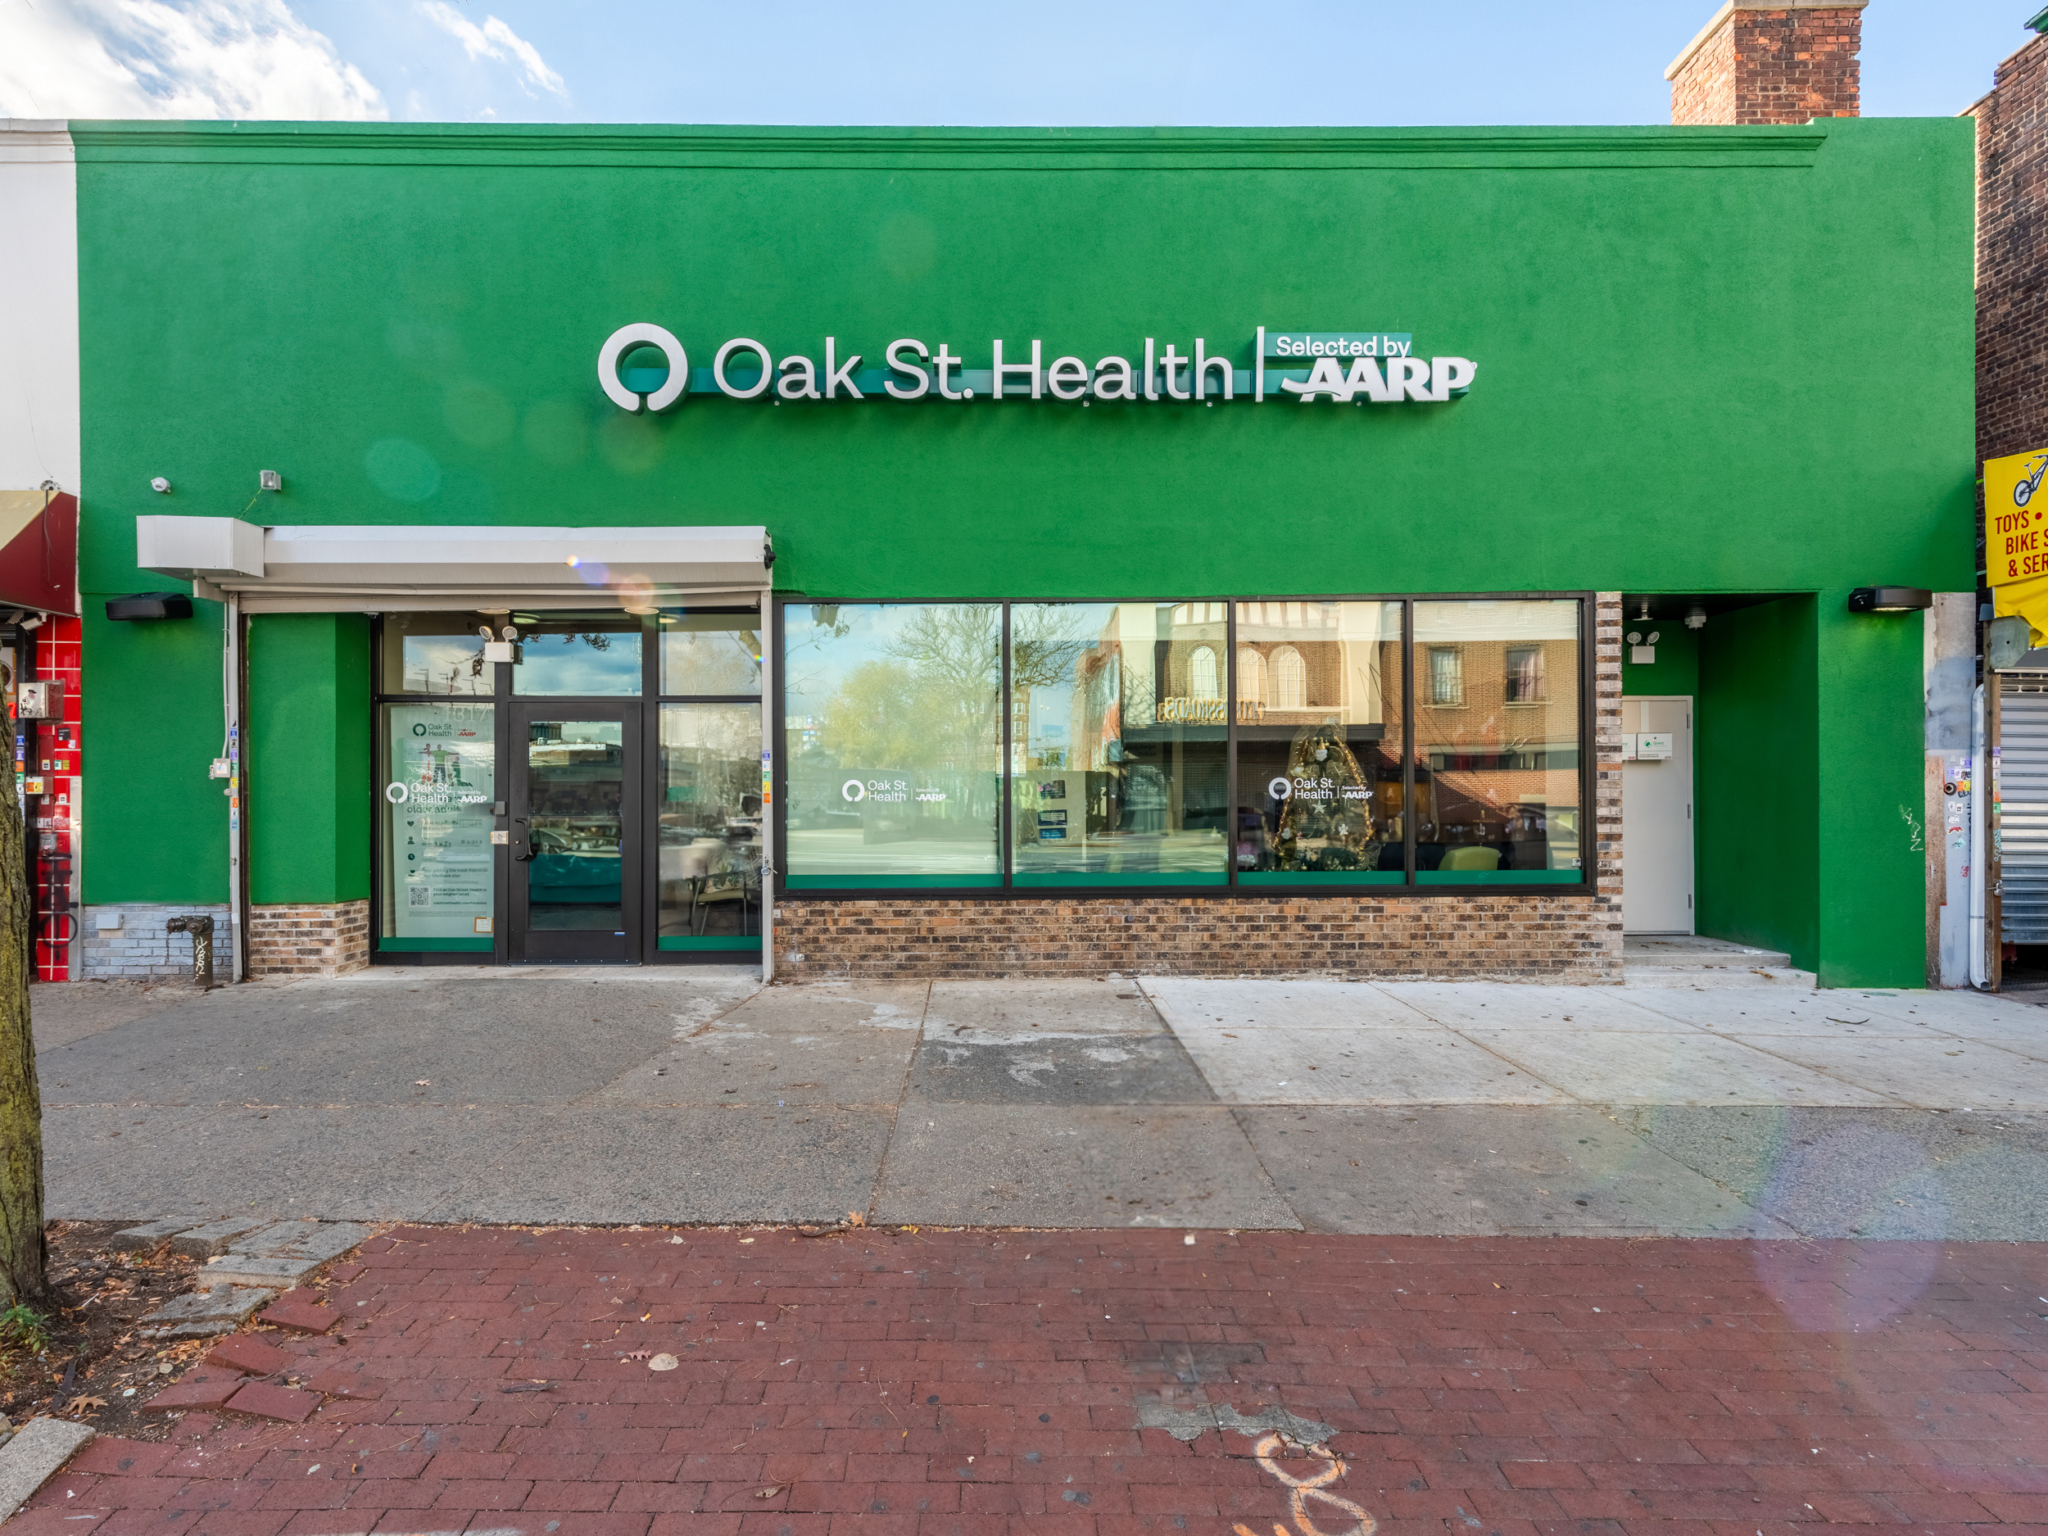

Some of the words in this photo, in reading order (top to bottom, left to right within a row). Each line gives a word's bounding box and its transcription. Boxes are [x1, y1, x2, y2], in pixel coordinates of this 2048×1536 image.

[1276, 335, 1377, 356] Selected
[1383, 335, 1411, 358] by
[713, 337, 865, 400] Oak
[884, 338, 974, 400] St.
[993, 337, 1234, 401] Health
[1281, 356, 1476, 402] AARP
[1994, 510, 2030, 535] TOYS
[2005, 531, 2039, 556] BIKE
[2008, 559, 2019, 577] &
[2023, 552, 2048, 575] SER
[411, 782, 434, 793] Oak
[868, 780, 891, 791] Oak
[894, 780, 909, 791] St.
[1294, 778, 1317, 788] Oak
[411, 793, 449, 804] Health
[457, 795, 488, 804] AARP
[868, 791, 906, 801] Health
[916, 793, 947, 801] AARP
[1294, 789, 1333, 799] Health
[1342, 791, 1373, 799] AARP
